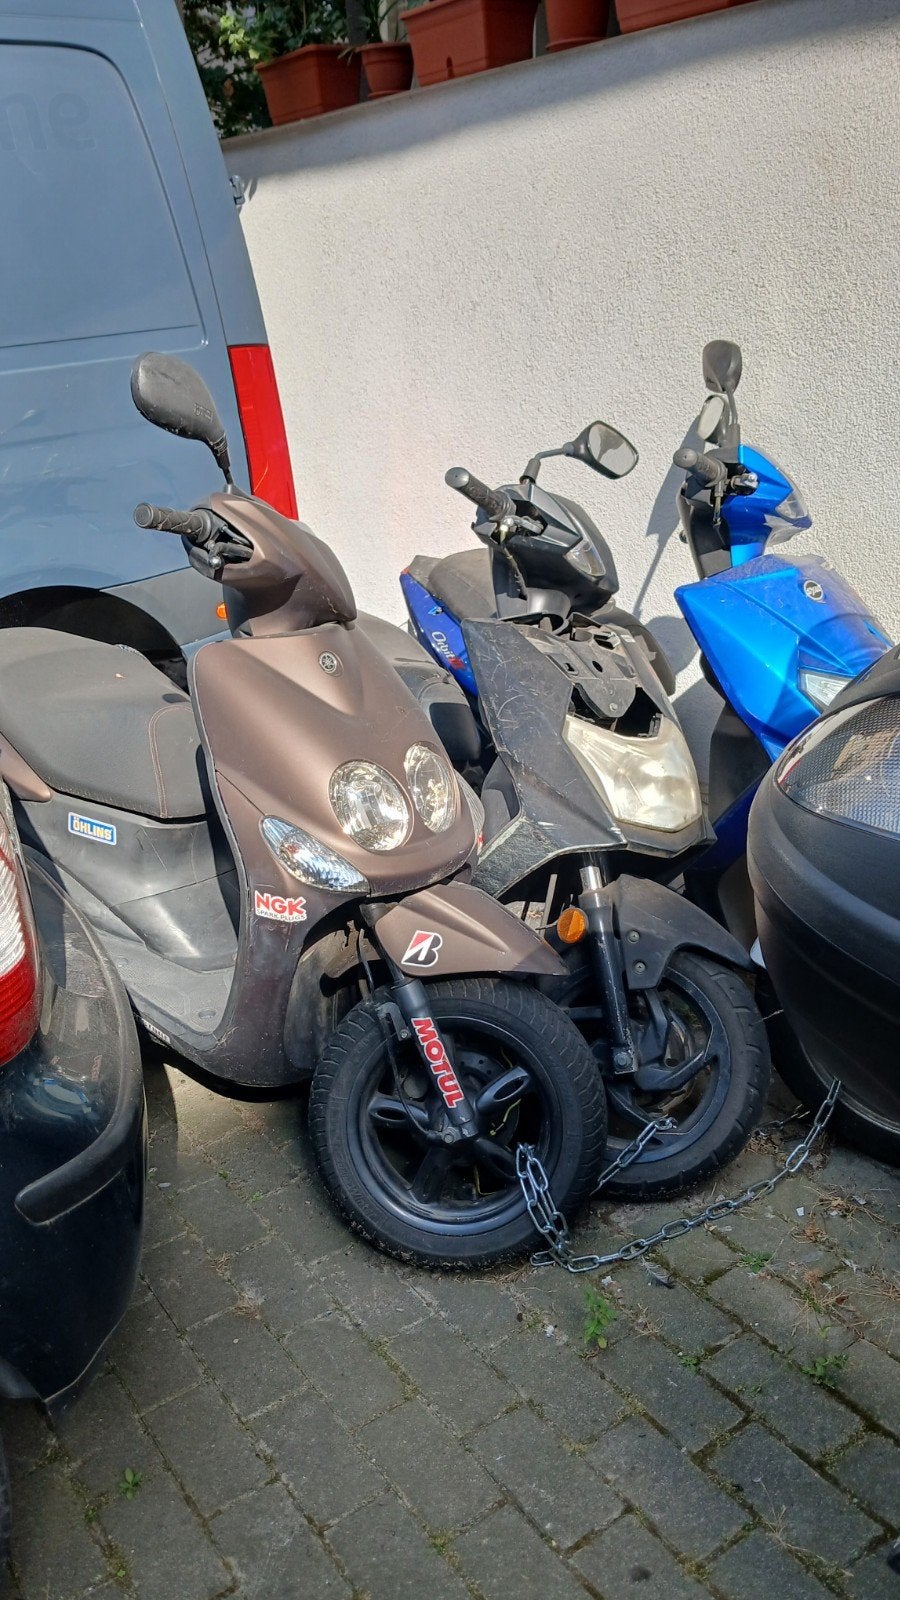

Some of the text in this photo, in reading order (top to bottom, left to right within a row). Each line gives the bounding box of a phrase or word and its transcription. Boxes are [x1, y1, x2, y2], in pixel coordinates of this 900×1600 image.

[432, 631, 455, 658] Orbit
[73, 816, 112, 840] ÖHLINS
[255, 890, 306, 916] NGK
[411, 1017, 465, 1108] MOTUL
